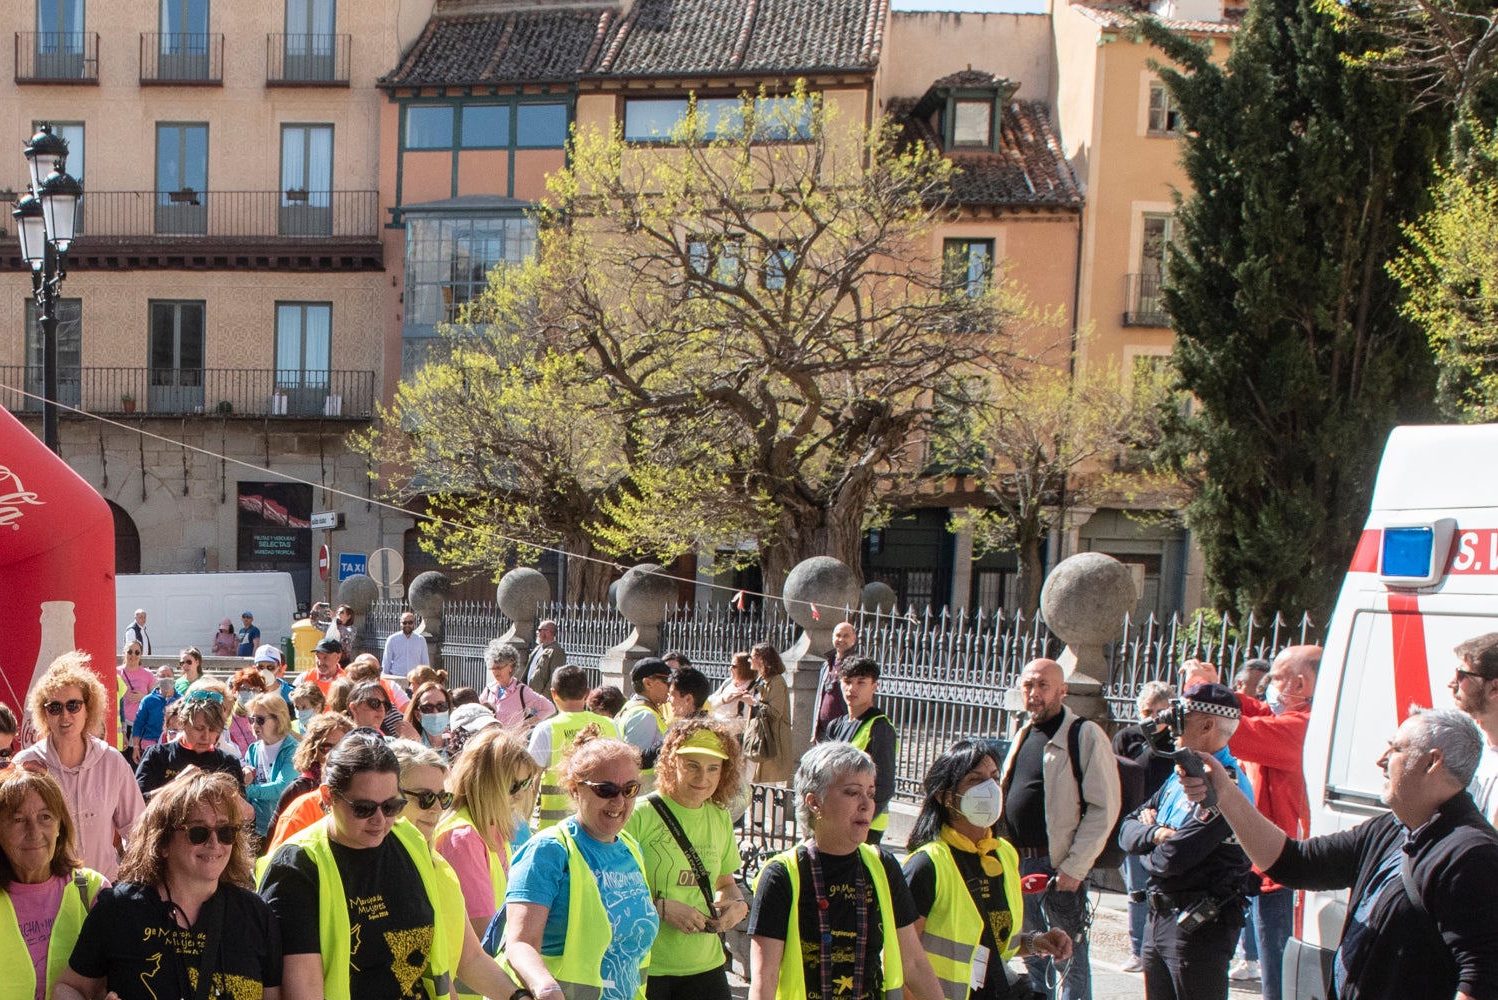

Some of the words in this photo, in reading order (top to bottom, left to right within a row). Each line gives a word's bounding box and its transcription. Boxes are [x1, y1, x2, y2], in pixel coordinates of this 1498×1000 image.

[341, 562, 366, 573] TAXI
[679, 871, 695, 885] 01
[358, 902, 386, 915] Mujeres
